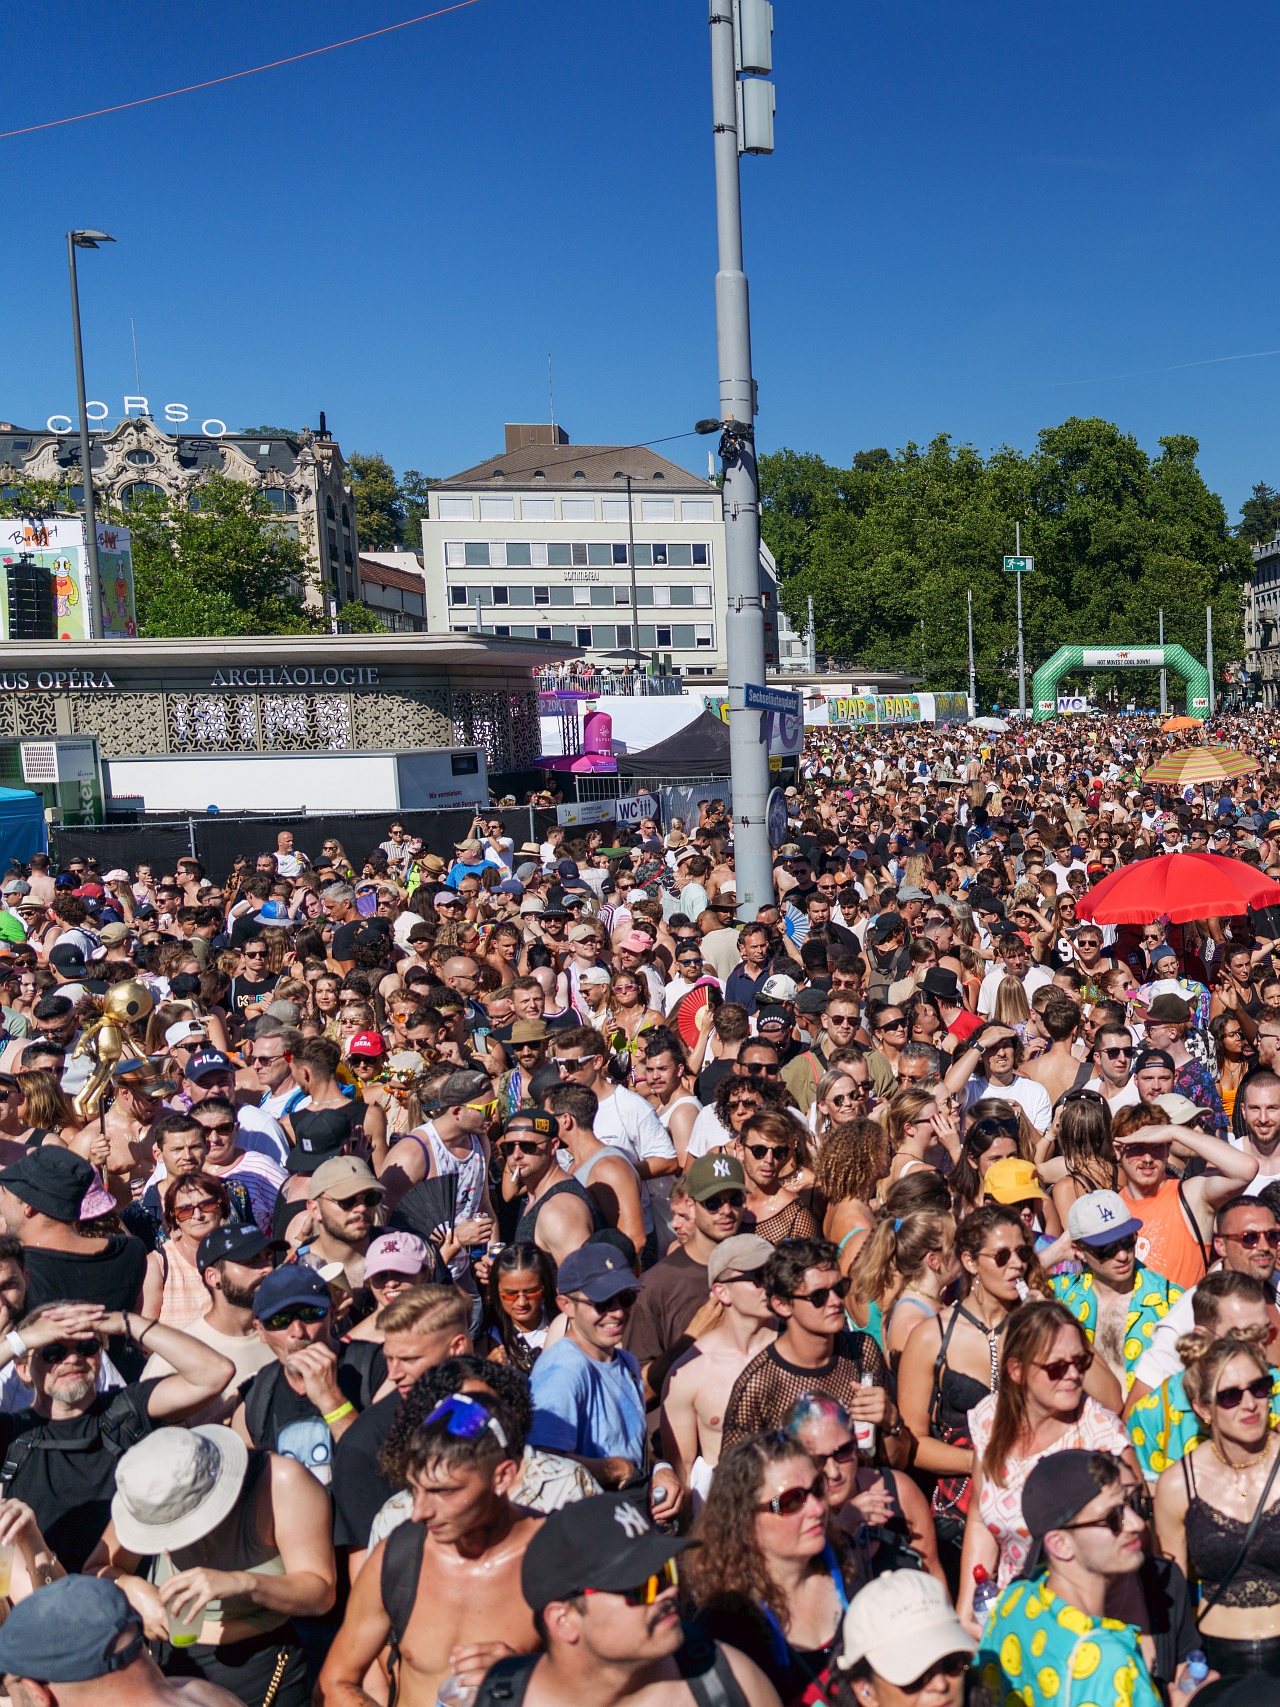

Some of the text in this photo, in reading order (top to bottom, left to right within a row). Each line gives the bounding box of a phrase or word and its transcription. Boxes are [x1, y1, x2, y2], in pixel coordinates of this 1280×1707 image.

[46, 396, 227, 438] CORSO
[0, 667, 116, 690] US OPÉRA
[211, 663, 380, 687] ARCHÄOLOGIE
[748, 688, 797, 710] Sechseläutenplatz
[837, 699, 867, 719] BAR
[885, 697, 912, 718] BAR
[619, 802, 638, 820] WC
[193, 1053, 224, 1068] FILA
[712, 1158, 731, 1178] NY
[1096, 1203, 1115, 1223] LA
[613, 1501, 650, 1539] NY
